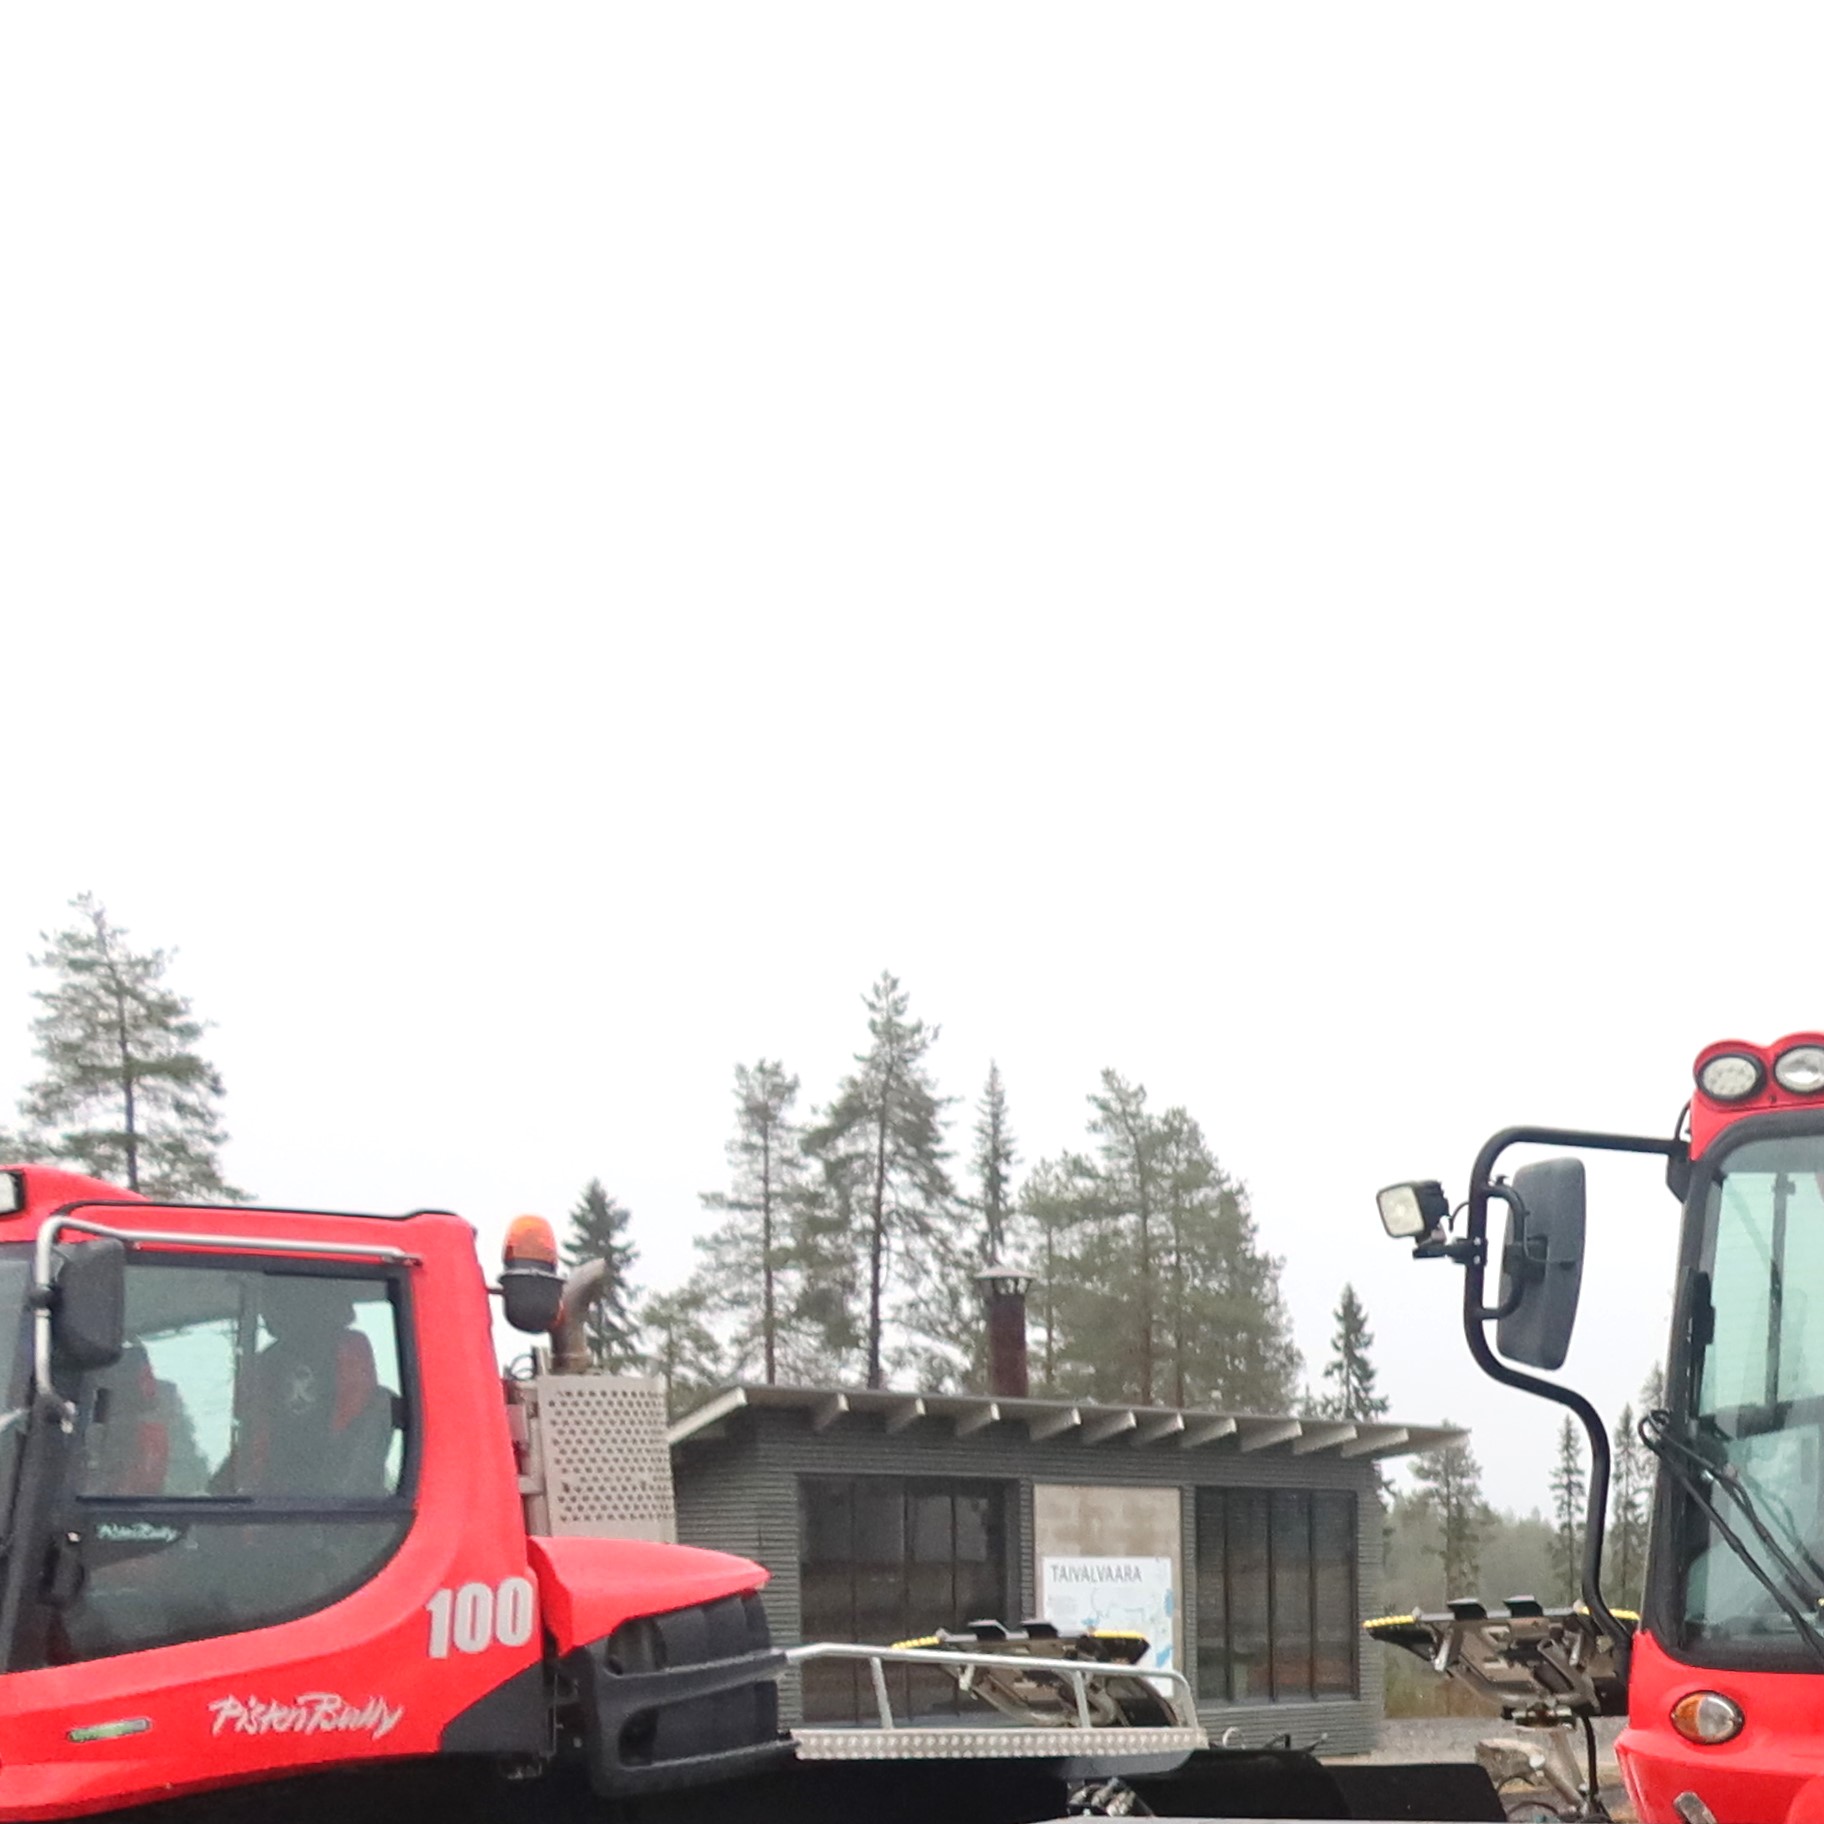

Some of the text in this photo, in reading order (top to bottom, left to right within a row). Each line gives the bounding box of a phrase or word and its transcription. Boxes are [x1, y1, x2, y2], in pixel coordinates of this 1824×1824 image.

[1050, 1564, 1143, 1583] TAIVALVAARA
[425, 1577, 533, 1659] 100
[208, 1691, 404, 1741] PistenBully
